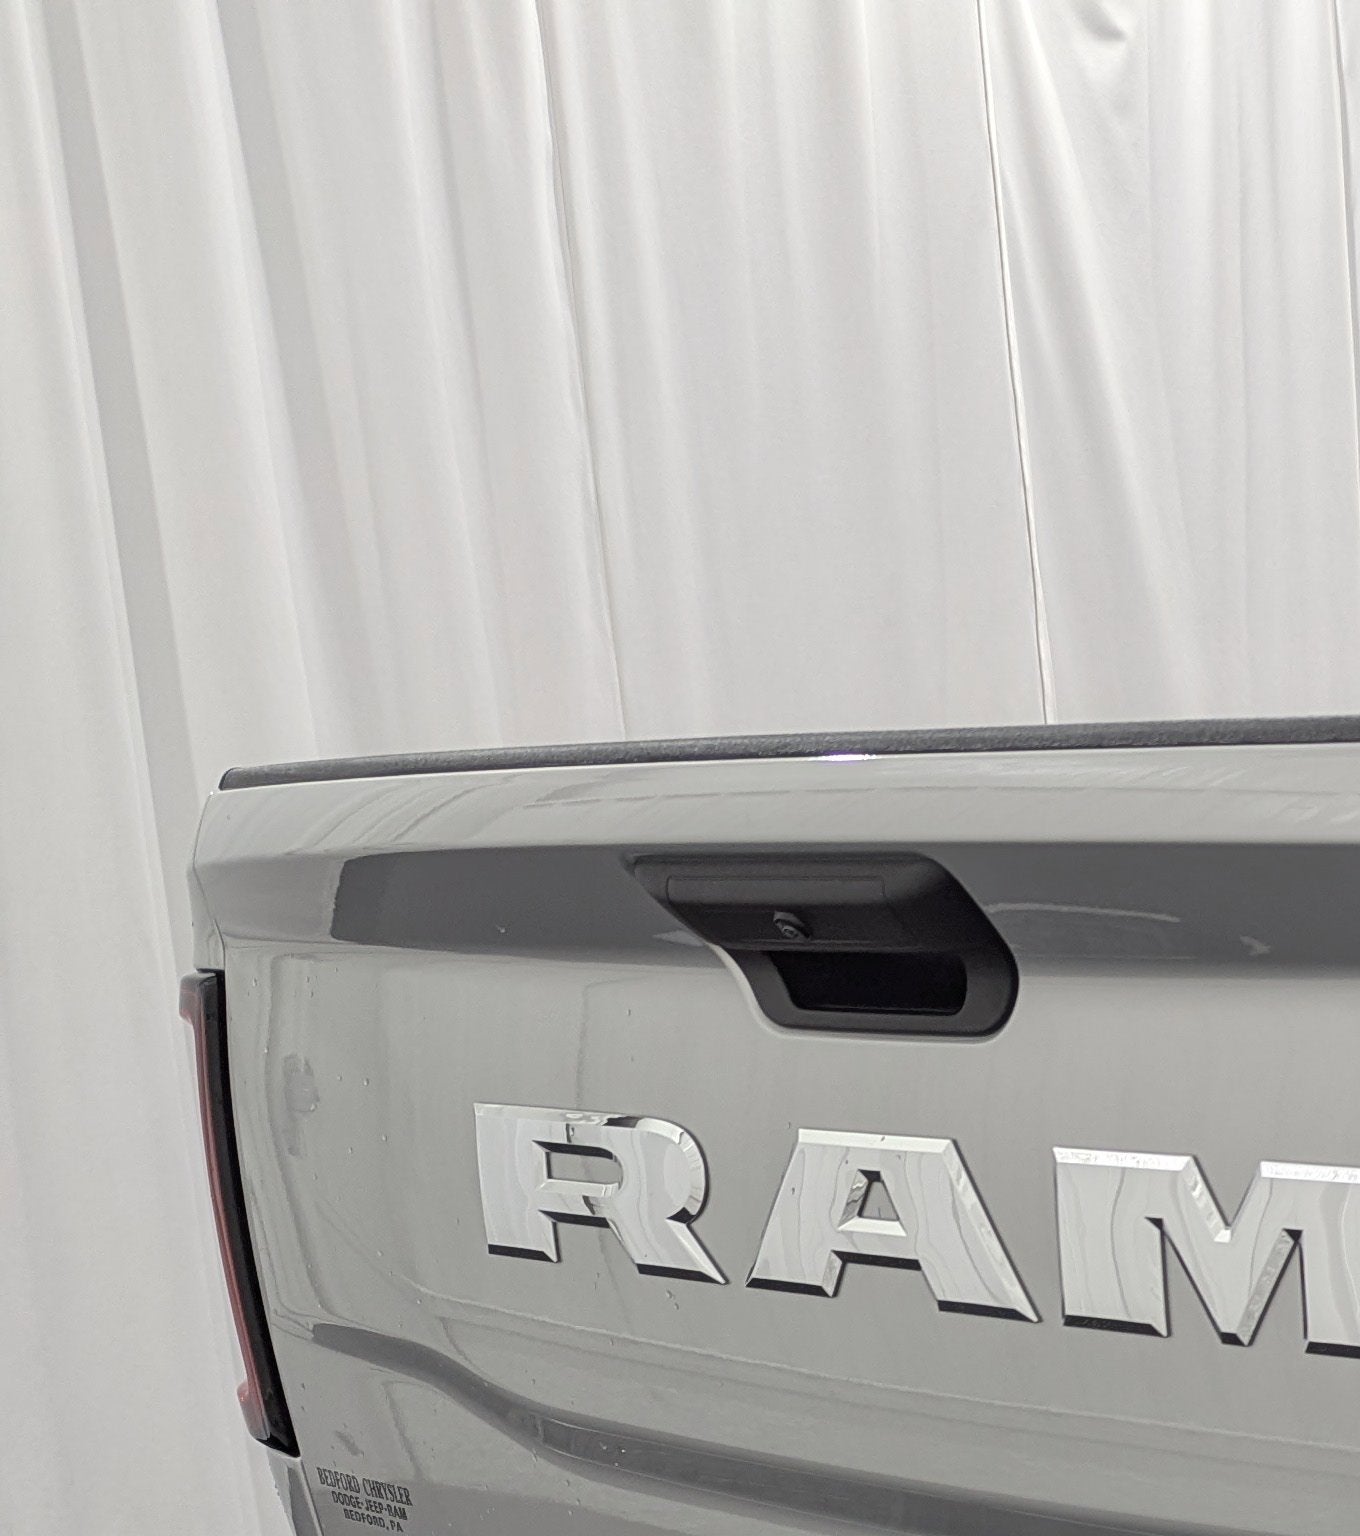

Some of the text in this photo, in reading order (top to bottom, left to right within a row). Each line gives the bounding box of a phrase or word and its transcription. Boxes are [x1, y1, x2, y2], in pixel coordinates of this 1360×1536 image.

[318, 1467, 413, 1506] BEDFORD CHRYSLER
[390, 1520, 404, 1533] PA
